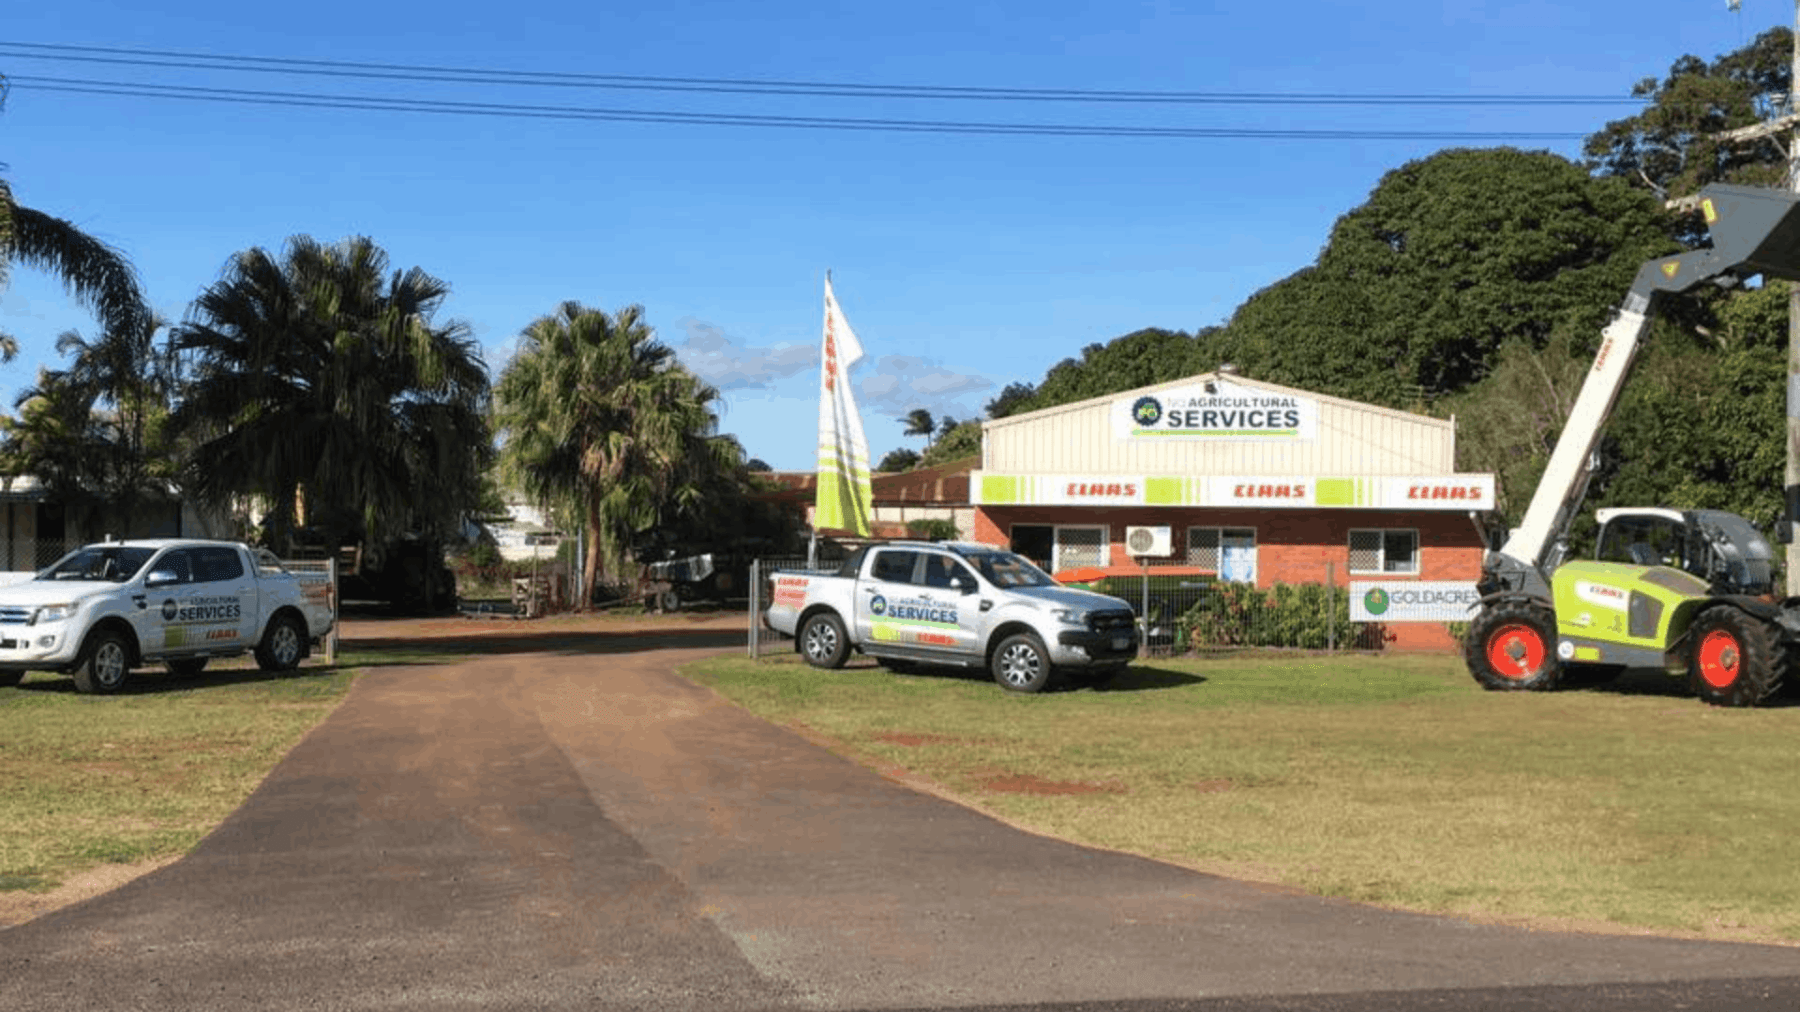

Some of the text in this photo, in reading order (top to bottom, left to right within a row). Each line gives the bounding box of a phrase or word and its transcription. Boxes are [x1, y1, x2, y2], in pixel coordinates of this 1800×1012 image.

[1188, 397, 1298, 408] AGRICULTURAL
[1167, 410, 1299, 428] SERVICES
[1067, 483, 1136, 496] CLAAS
[1234, 485, 1305, 498] CLAAS
[1408, 486, 1482, 500] CLAAS
[179, 604, 241, 620] SERVICES
[888, 605, 958, 624] SERVICES
